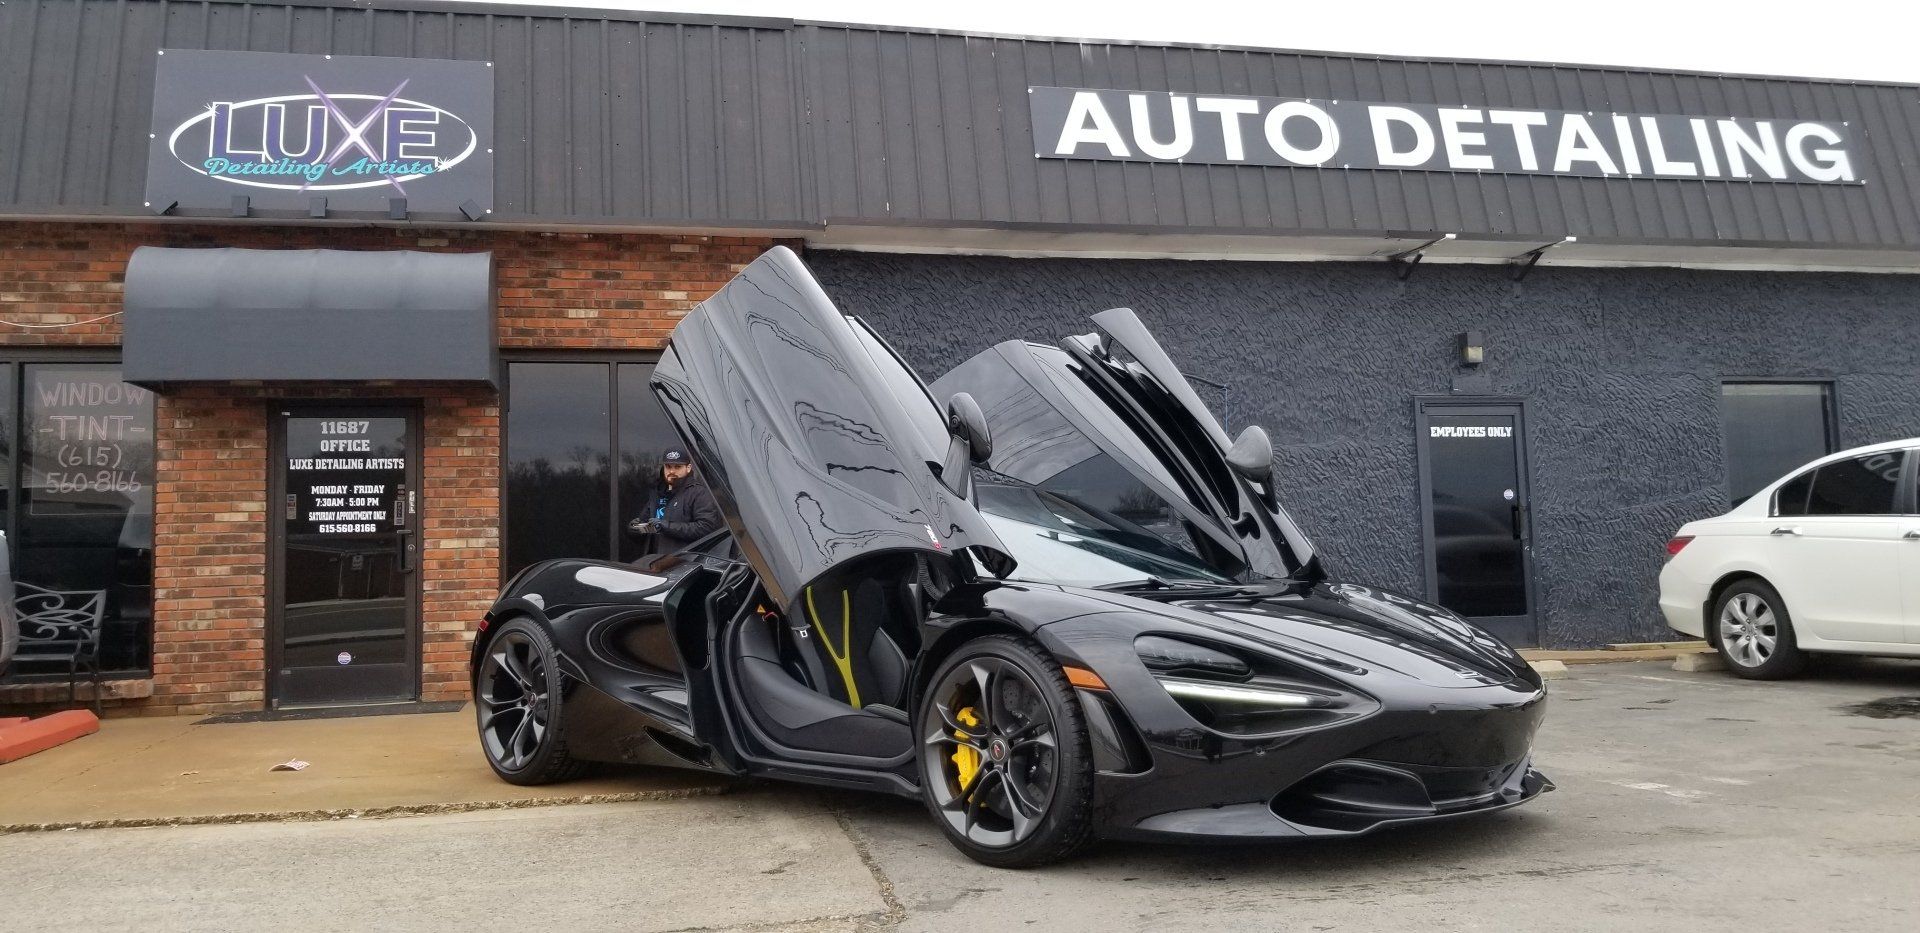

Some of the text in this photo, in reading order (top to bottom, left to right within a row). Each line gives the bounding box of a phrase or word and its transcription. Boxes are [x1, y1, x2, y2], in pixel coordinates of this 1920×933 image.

[208, 75, 440, 192] LUXE
[1055, 91, 1855, 182] AUTO DETAILING
[204, 157, 435, 182] Detailing Artists
[38, 382, 146, 408] WINDOW
[320, 421, 370, 435] 11687
[1430, 426, 1512, 437] EMPLOYEES ONLY
[320, 439, 370, 452] OFFICE
[58, 444, 122, 468] (615)
[289, 458, 405, 470] LUXE DETAILING ARTISTS
[46, 470, 142, 494] 560-8166
[311, 485, 347, 495] MONDAY
[353, 485, 385, 494] FRIDAY
[315, 498, 344, 507] 7:30AM
[349, 498, 366, 506] 5:00
[367, 498, 379, 506] PM
[308, 511, 336, 522] SATURDAY
[336, 511, 372, 521] APPOINTMENT
[373, 510, 386, 521] ONLY
[319, 524, 376, 533] 615-560-8166
